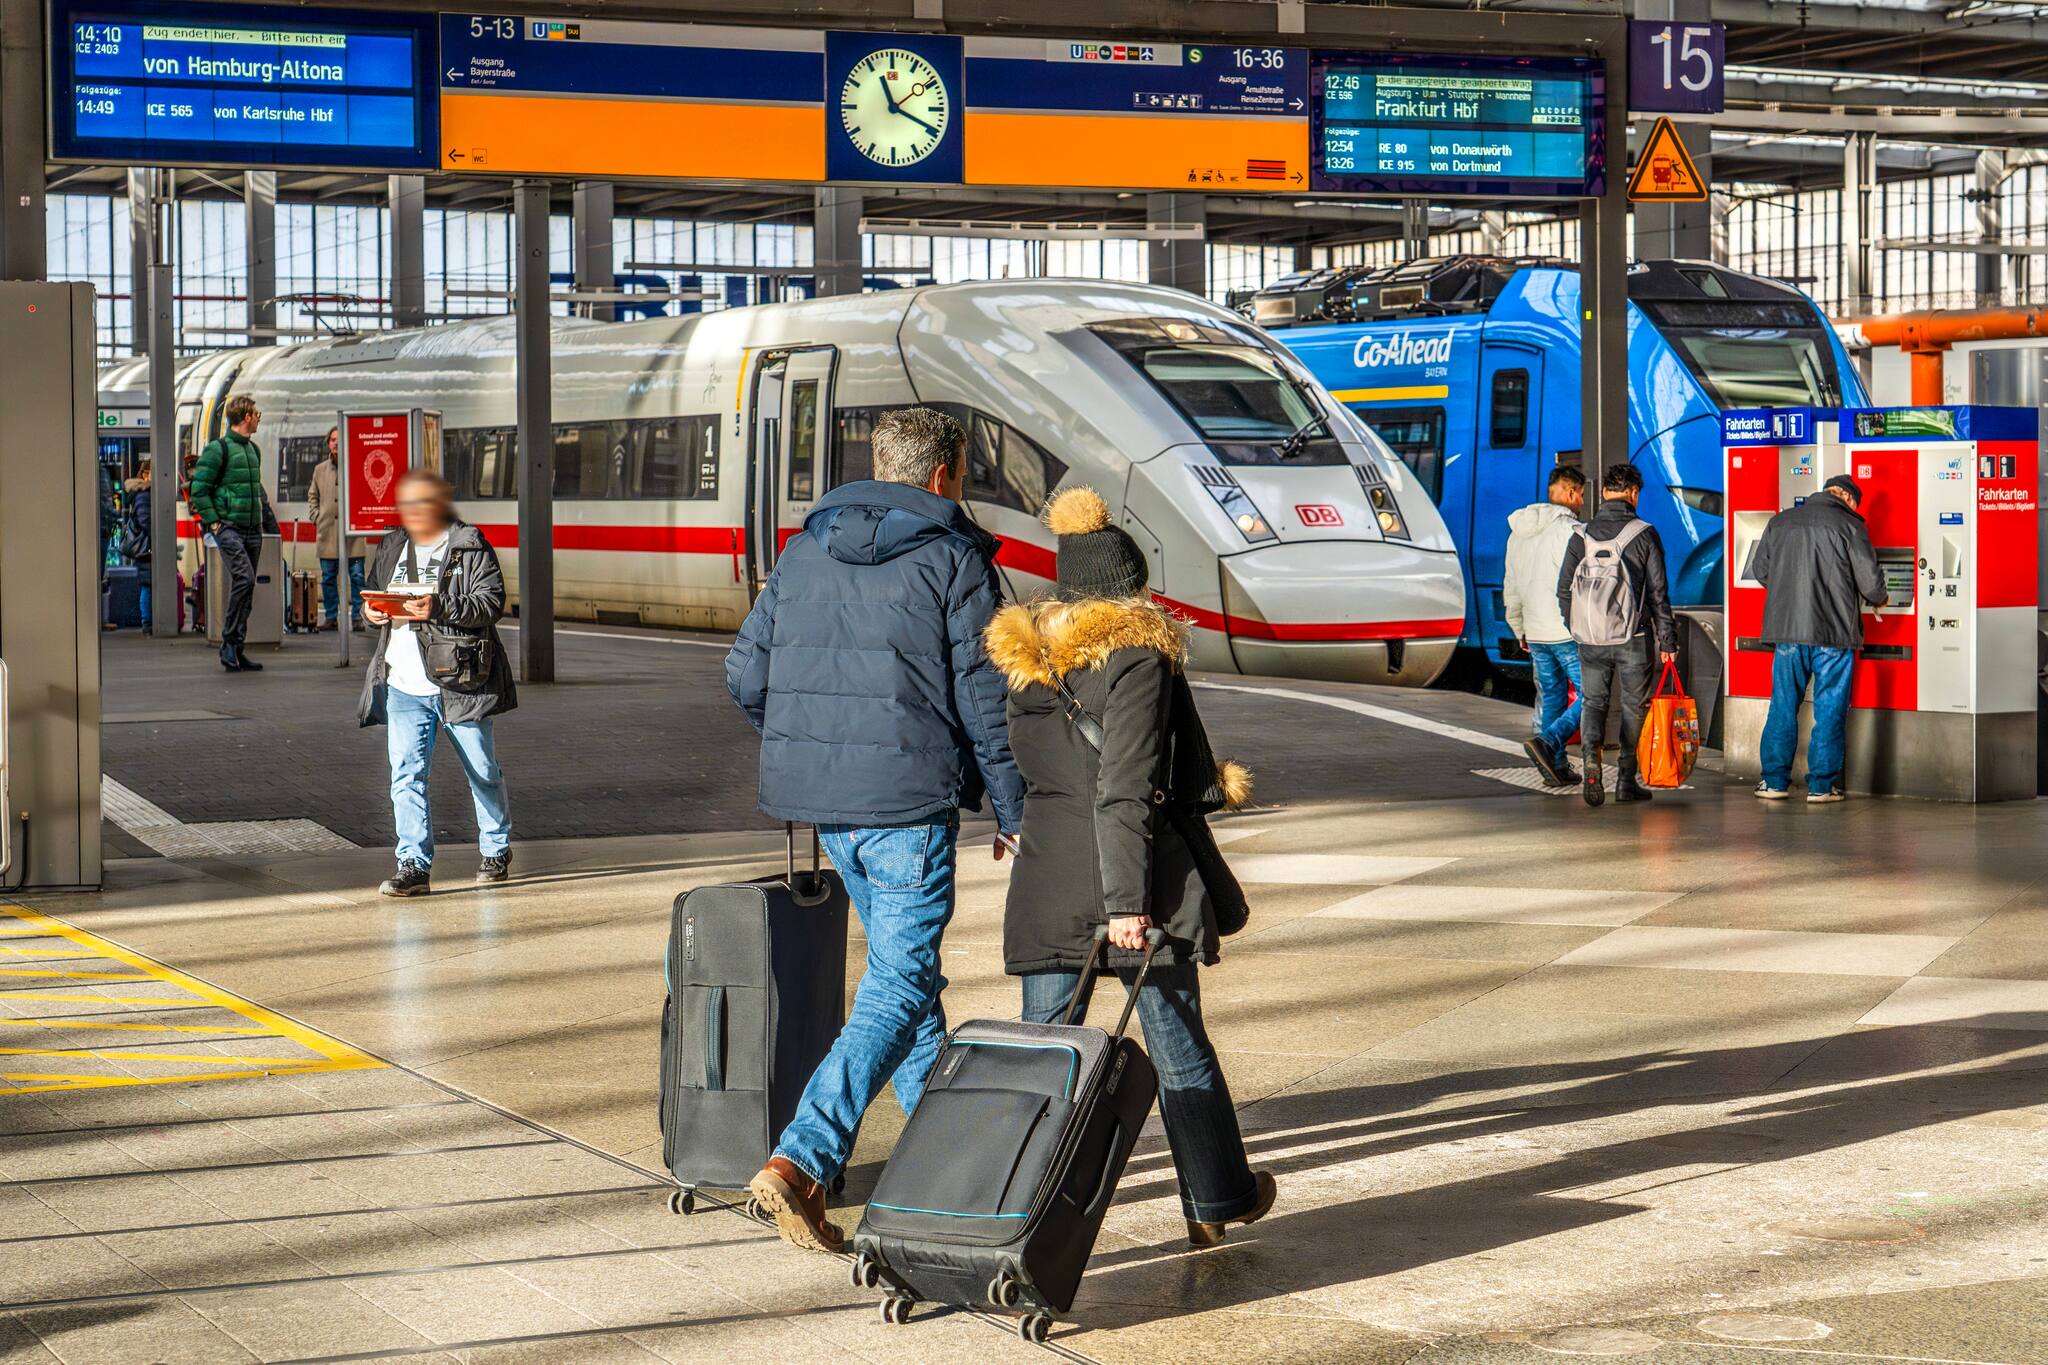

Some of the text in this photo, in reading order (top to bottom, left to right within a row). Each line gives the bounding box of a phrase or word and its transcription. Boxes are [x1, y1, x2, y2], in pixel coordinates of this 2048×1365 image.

[77, 25, 121, 42] 14:10
[470, 16, 515, 39] 5-13
[534, 23, 546, 38] U
[147, 27, 168, 38] Zug
[174, 29, 208, 39] endet
[262, 32, 290, 42] Bitte
[296, 34, 323, 44] nicht
[76, 43, 119, 54] ICE 2403
[1072, 45, 1082, 58] U
[1189, 49, 1201, 62] S
[470, 56, 504, 68] Ausgang
[1233, 48, 1284, 69] 16-36
[1651, 26, 1713, 91] 15
[144, 55, 343, 82] von Hamburg-Altona
[470, 67, 516, 78] Bayerstraße
[1219, 75, 1247, 85] Ausgang
[1324, 75, 1359, 90] 12:46
[1338, 91, 1353, 100] 596
[1448, 90, 1484, 101] Stuttgart
[77, 99, 333, 122] 14:49 ICE 565 von Karlsruhe Hbf
[1376, 100, 1479, 119] Frankfurt Hbf
[1325, 140, 1512, 157] 12:54 RE 80 von Donauwörth
[1325, 157, 1501, 173] 13:26 ICE 915 von Dortmund
[1726, 417, 1765, 431] Fahrkarten
[704, 425, 714, 457] 1
[1978, 487, 2029, 501] Fahrkarten
[1302, 507, 1338, 524] DB
